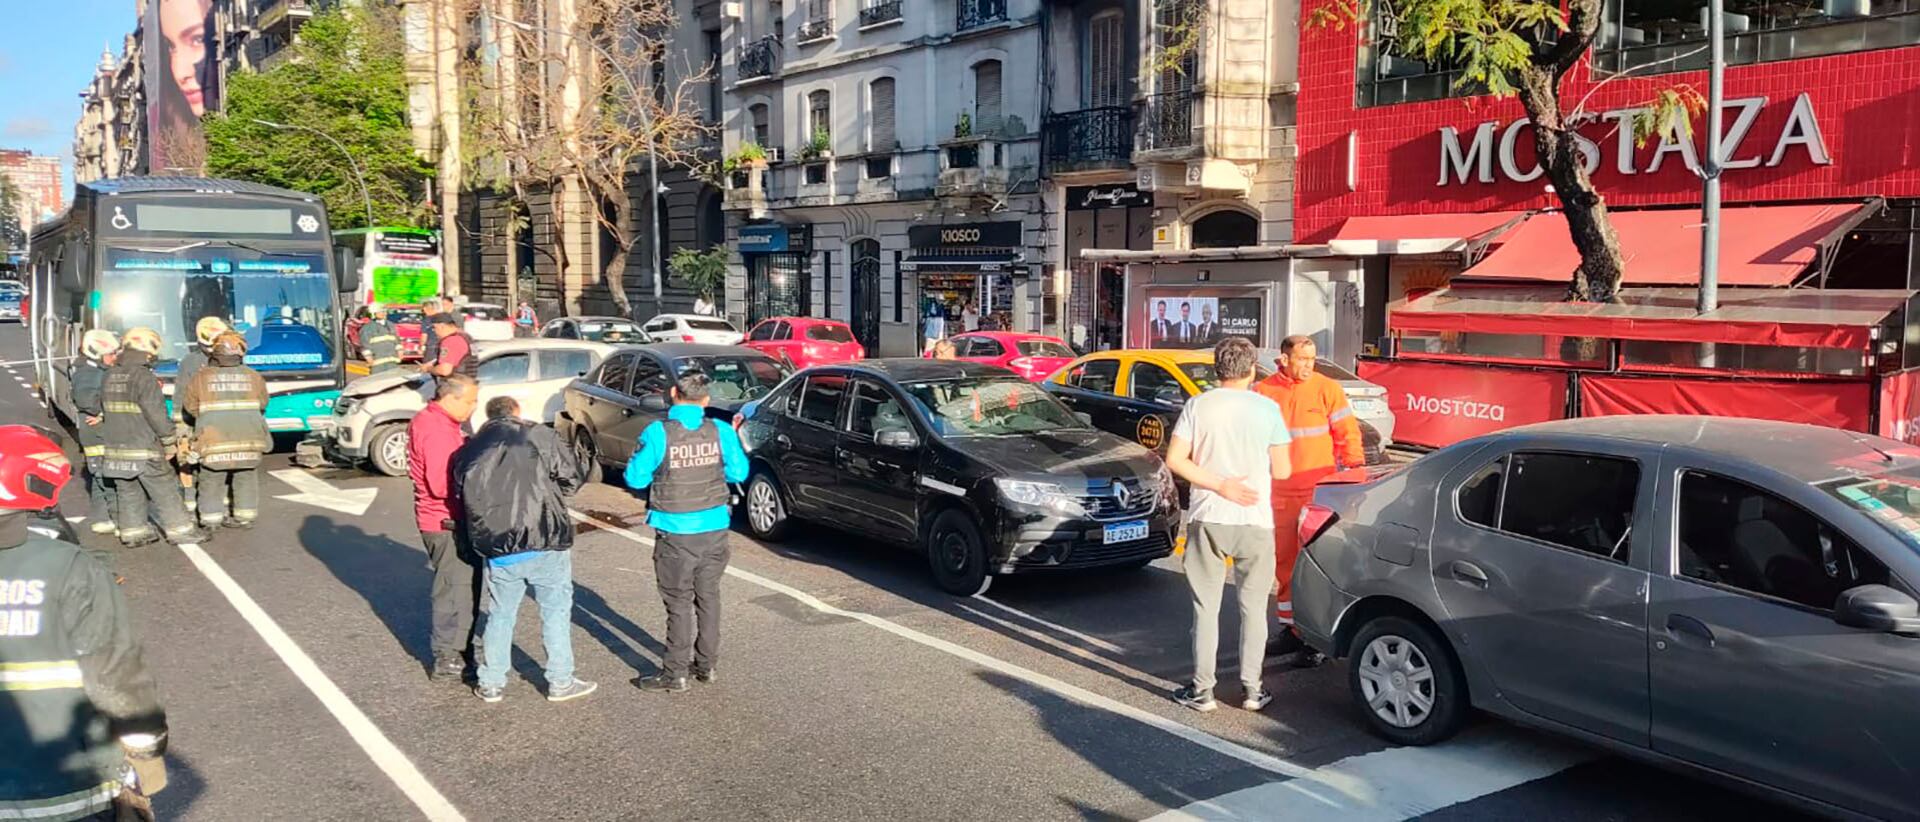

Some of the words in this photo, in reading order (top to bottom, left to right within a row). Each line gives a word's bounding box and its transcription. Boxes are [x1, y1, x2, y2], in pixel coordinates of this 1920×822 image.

[1436, 92, 1833, 186] MOSTAZA
[941, 229, 980, 242] KIOSCO
[1232, 318, 1258, 327] CARLO
[670, 442, 719, 460] POLICIA
[670, 460, 681, 469] DE
[683, 459, 694, 467] LA
[1118, 528, 1135, 540] 252
